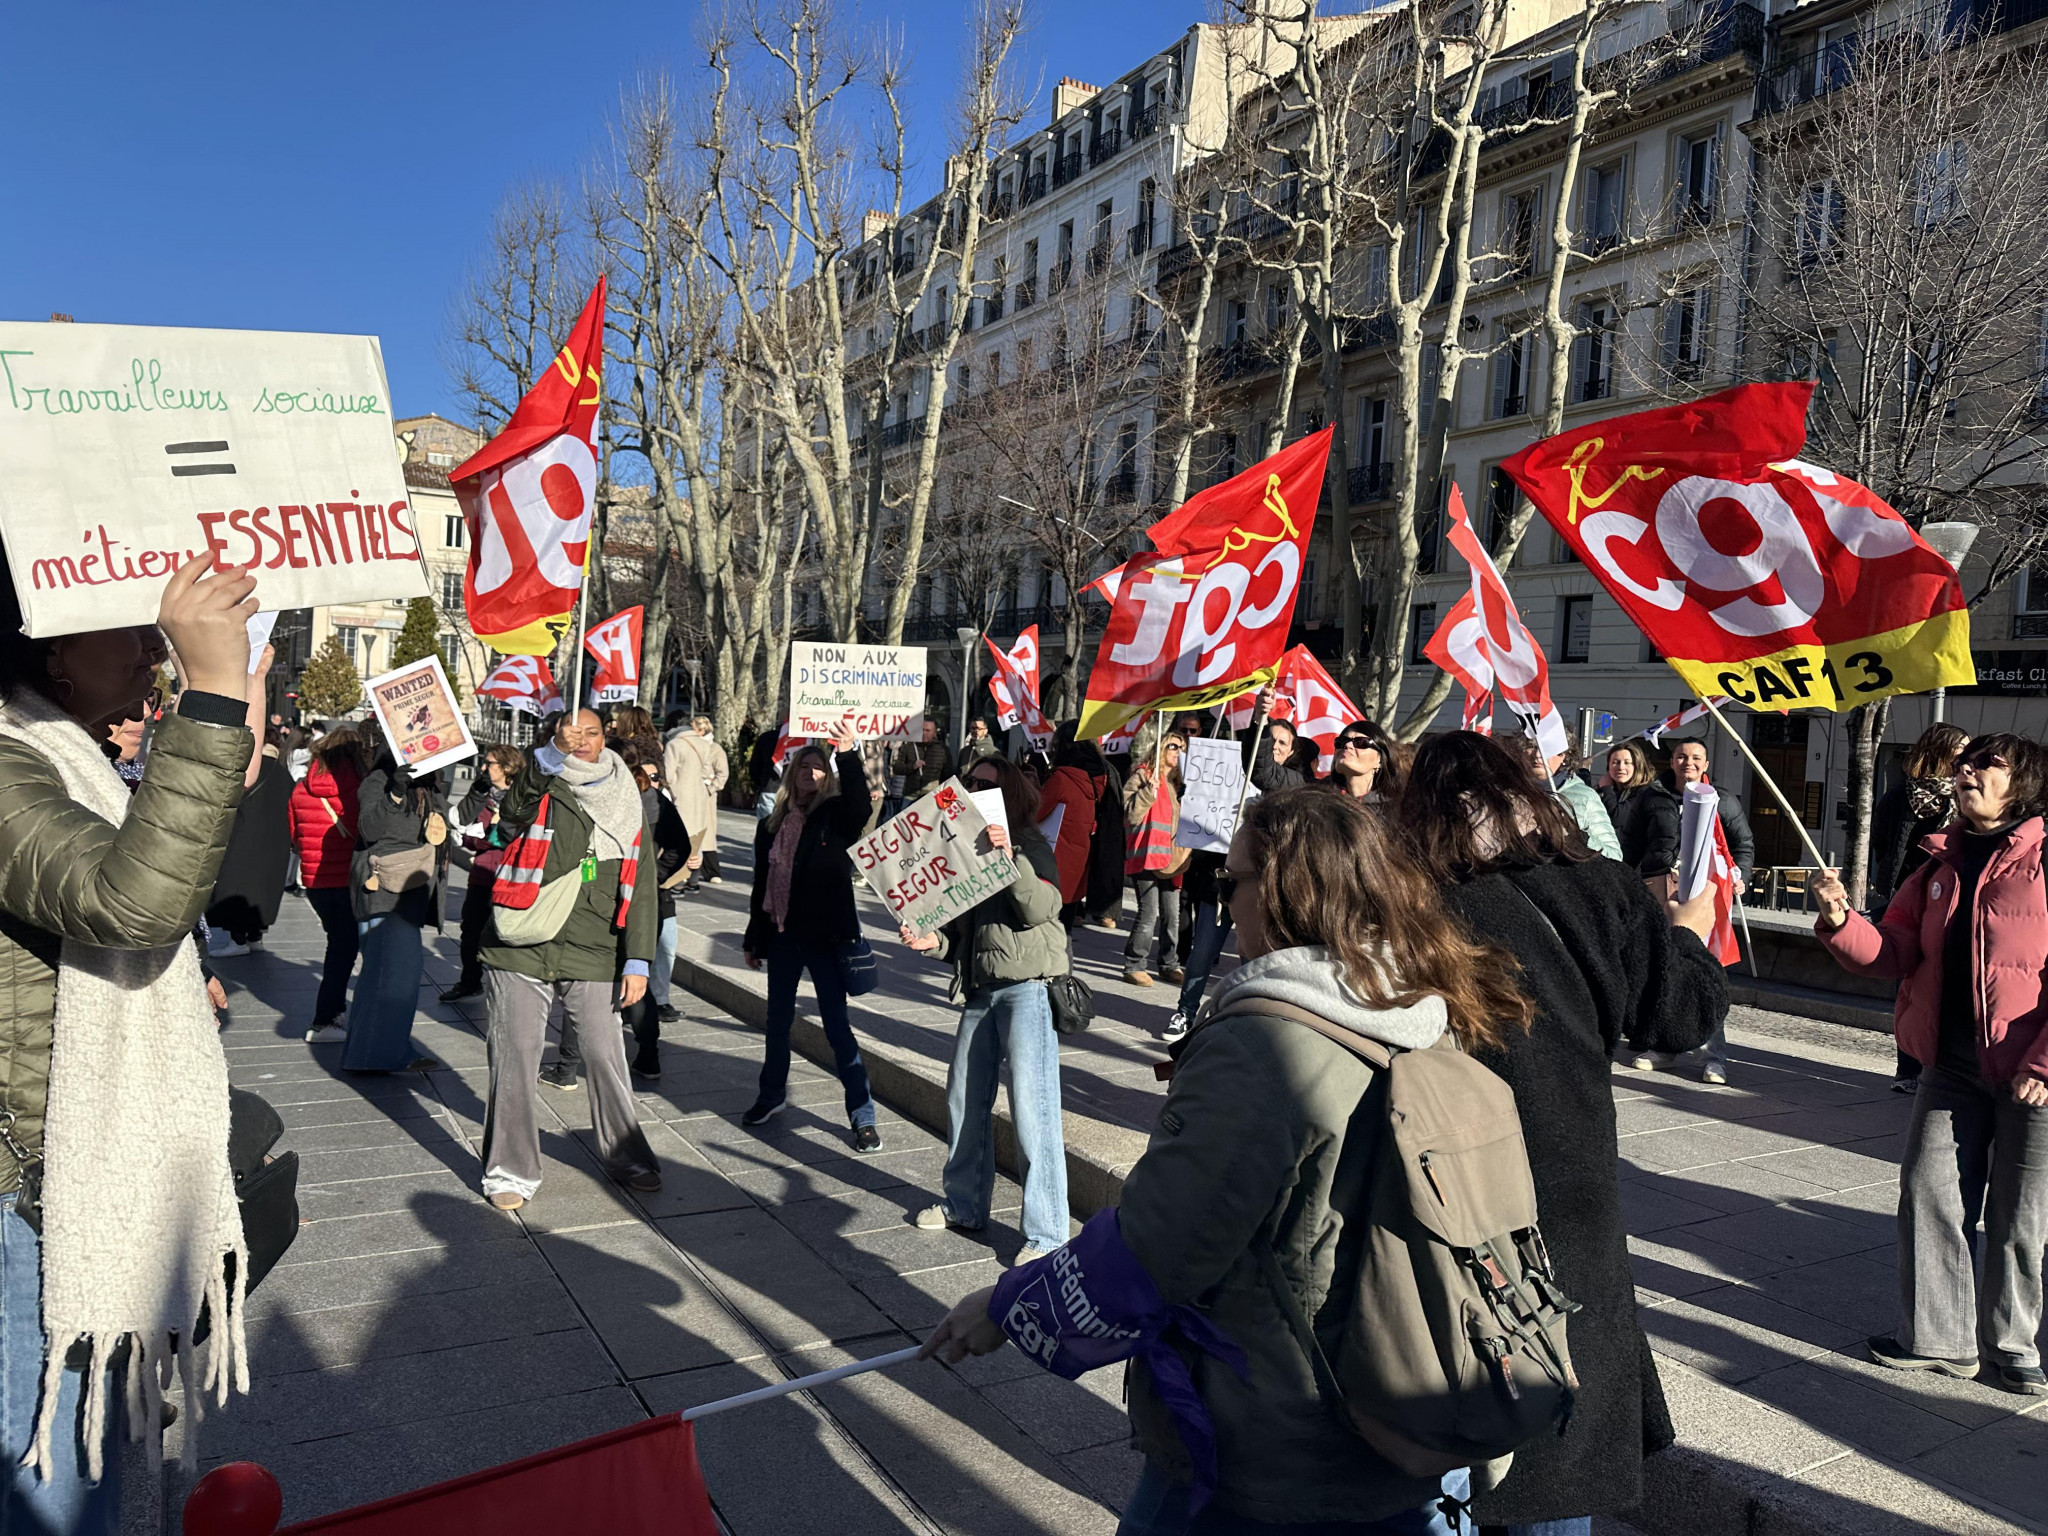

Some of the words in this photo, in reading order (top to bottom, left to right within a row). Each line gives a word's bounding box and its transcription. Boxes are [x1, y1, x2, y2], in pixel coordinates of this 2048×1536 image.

[0, 350, 229, 415] Travailleurs
[253, 387, 386, 414] sociaux
[812, 648, 846, 664] NON
[862, 650, 898, 666] AUX
[1717, 657, 1813, 703] CAF
[1977, 668, 2024, 681] kfast
[2029, 668, 2048, 681] Cl
[381, 673, 434, 702] WANTED
[393, 699, 415, 711] PRIME
[414, 690, 435, 703] SEGUR
[1032, 738, 1048, 750] 13
[1733, 749, 1739, 757] 9
[1815, 752, 1821, 761] 9
[1187, 814, 1234, 838] SUR
[857, 811, 933, 870] SEGUR
[899, 847, 930, 871] POUR
[940, 820, 957, 843] 1
[887, 856, 957, 911] SEGUR
[915, 904, 948, 929] POUR
[1008, 1303, 1060, 1362] cgt
